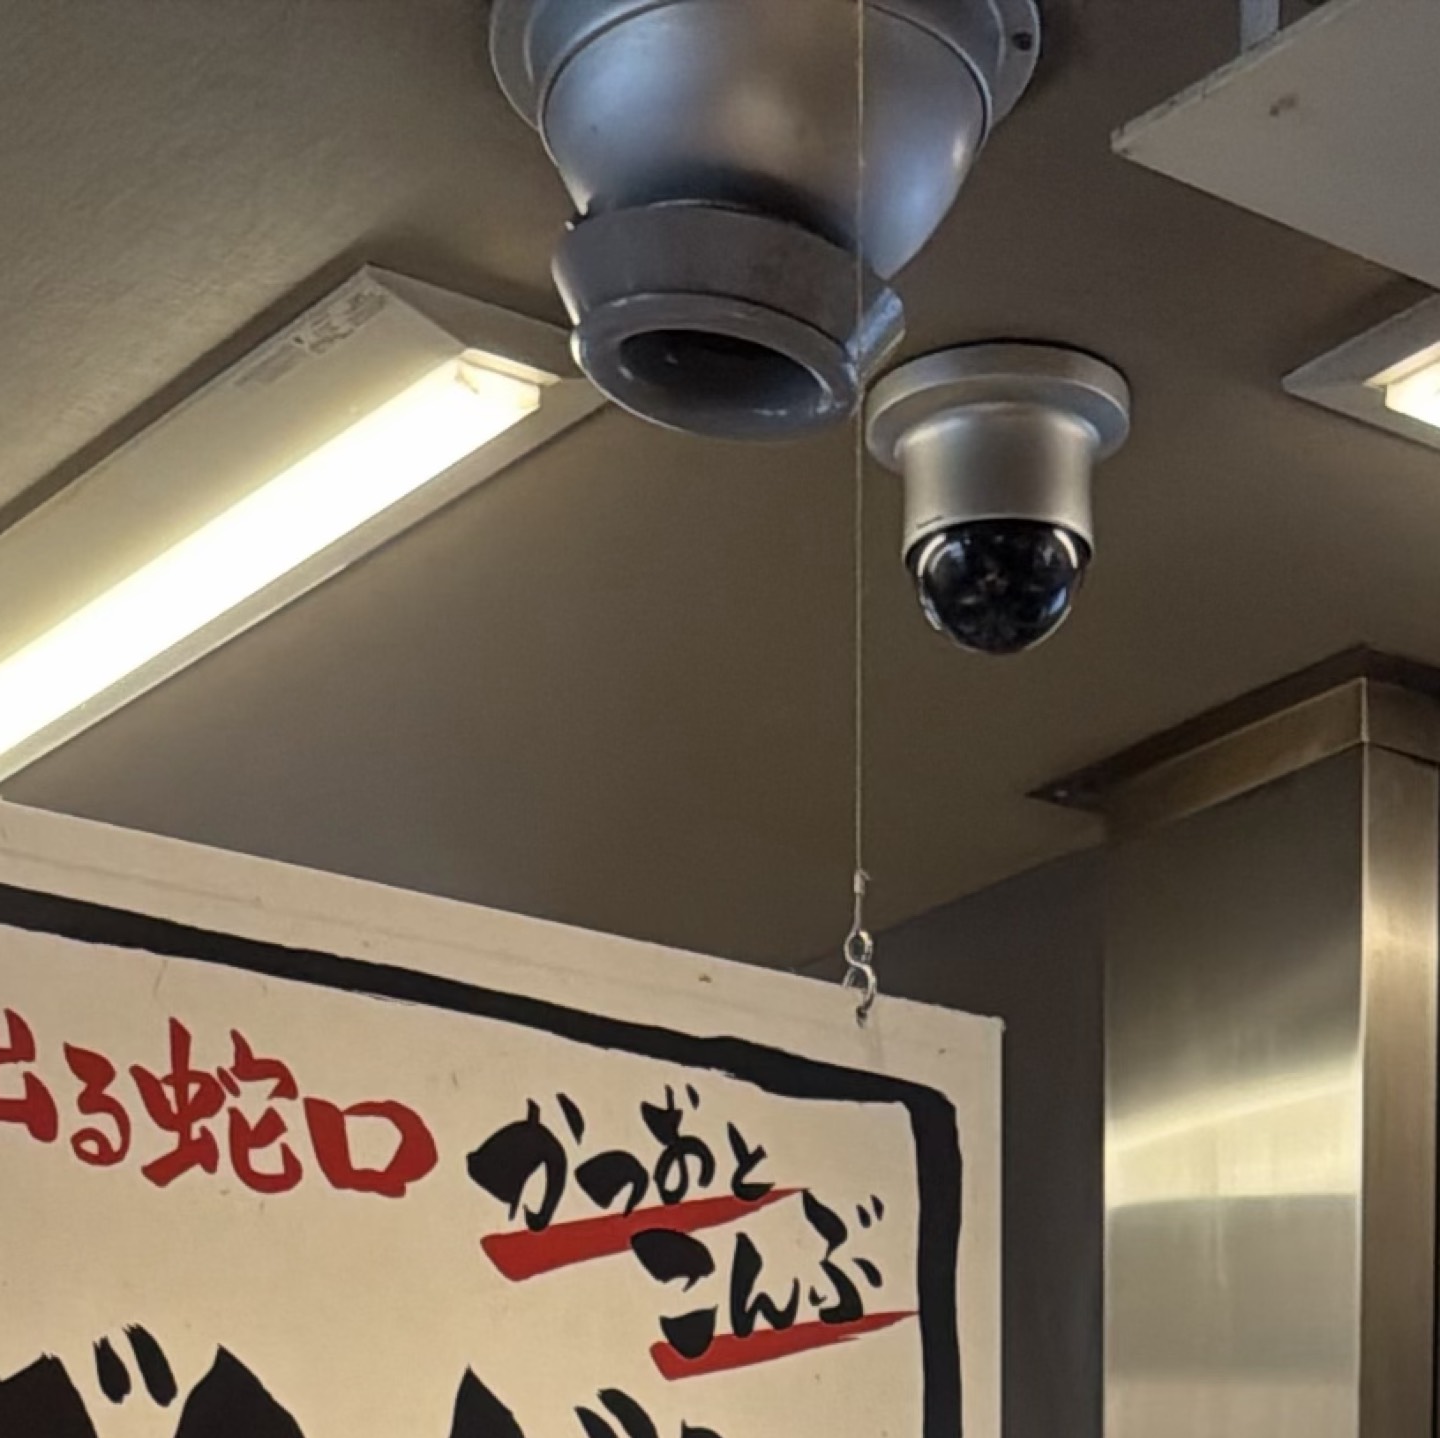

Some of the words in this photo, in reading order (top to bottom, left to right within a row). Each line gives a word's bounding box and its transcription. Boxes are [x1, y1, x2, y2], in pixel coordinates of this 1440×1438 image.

[467, 1085, 774, 1231] かつおと
[630, 1193, 884, 1358] こんぶ
